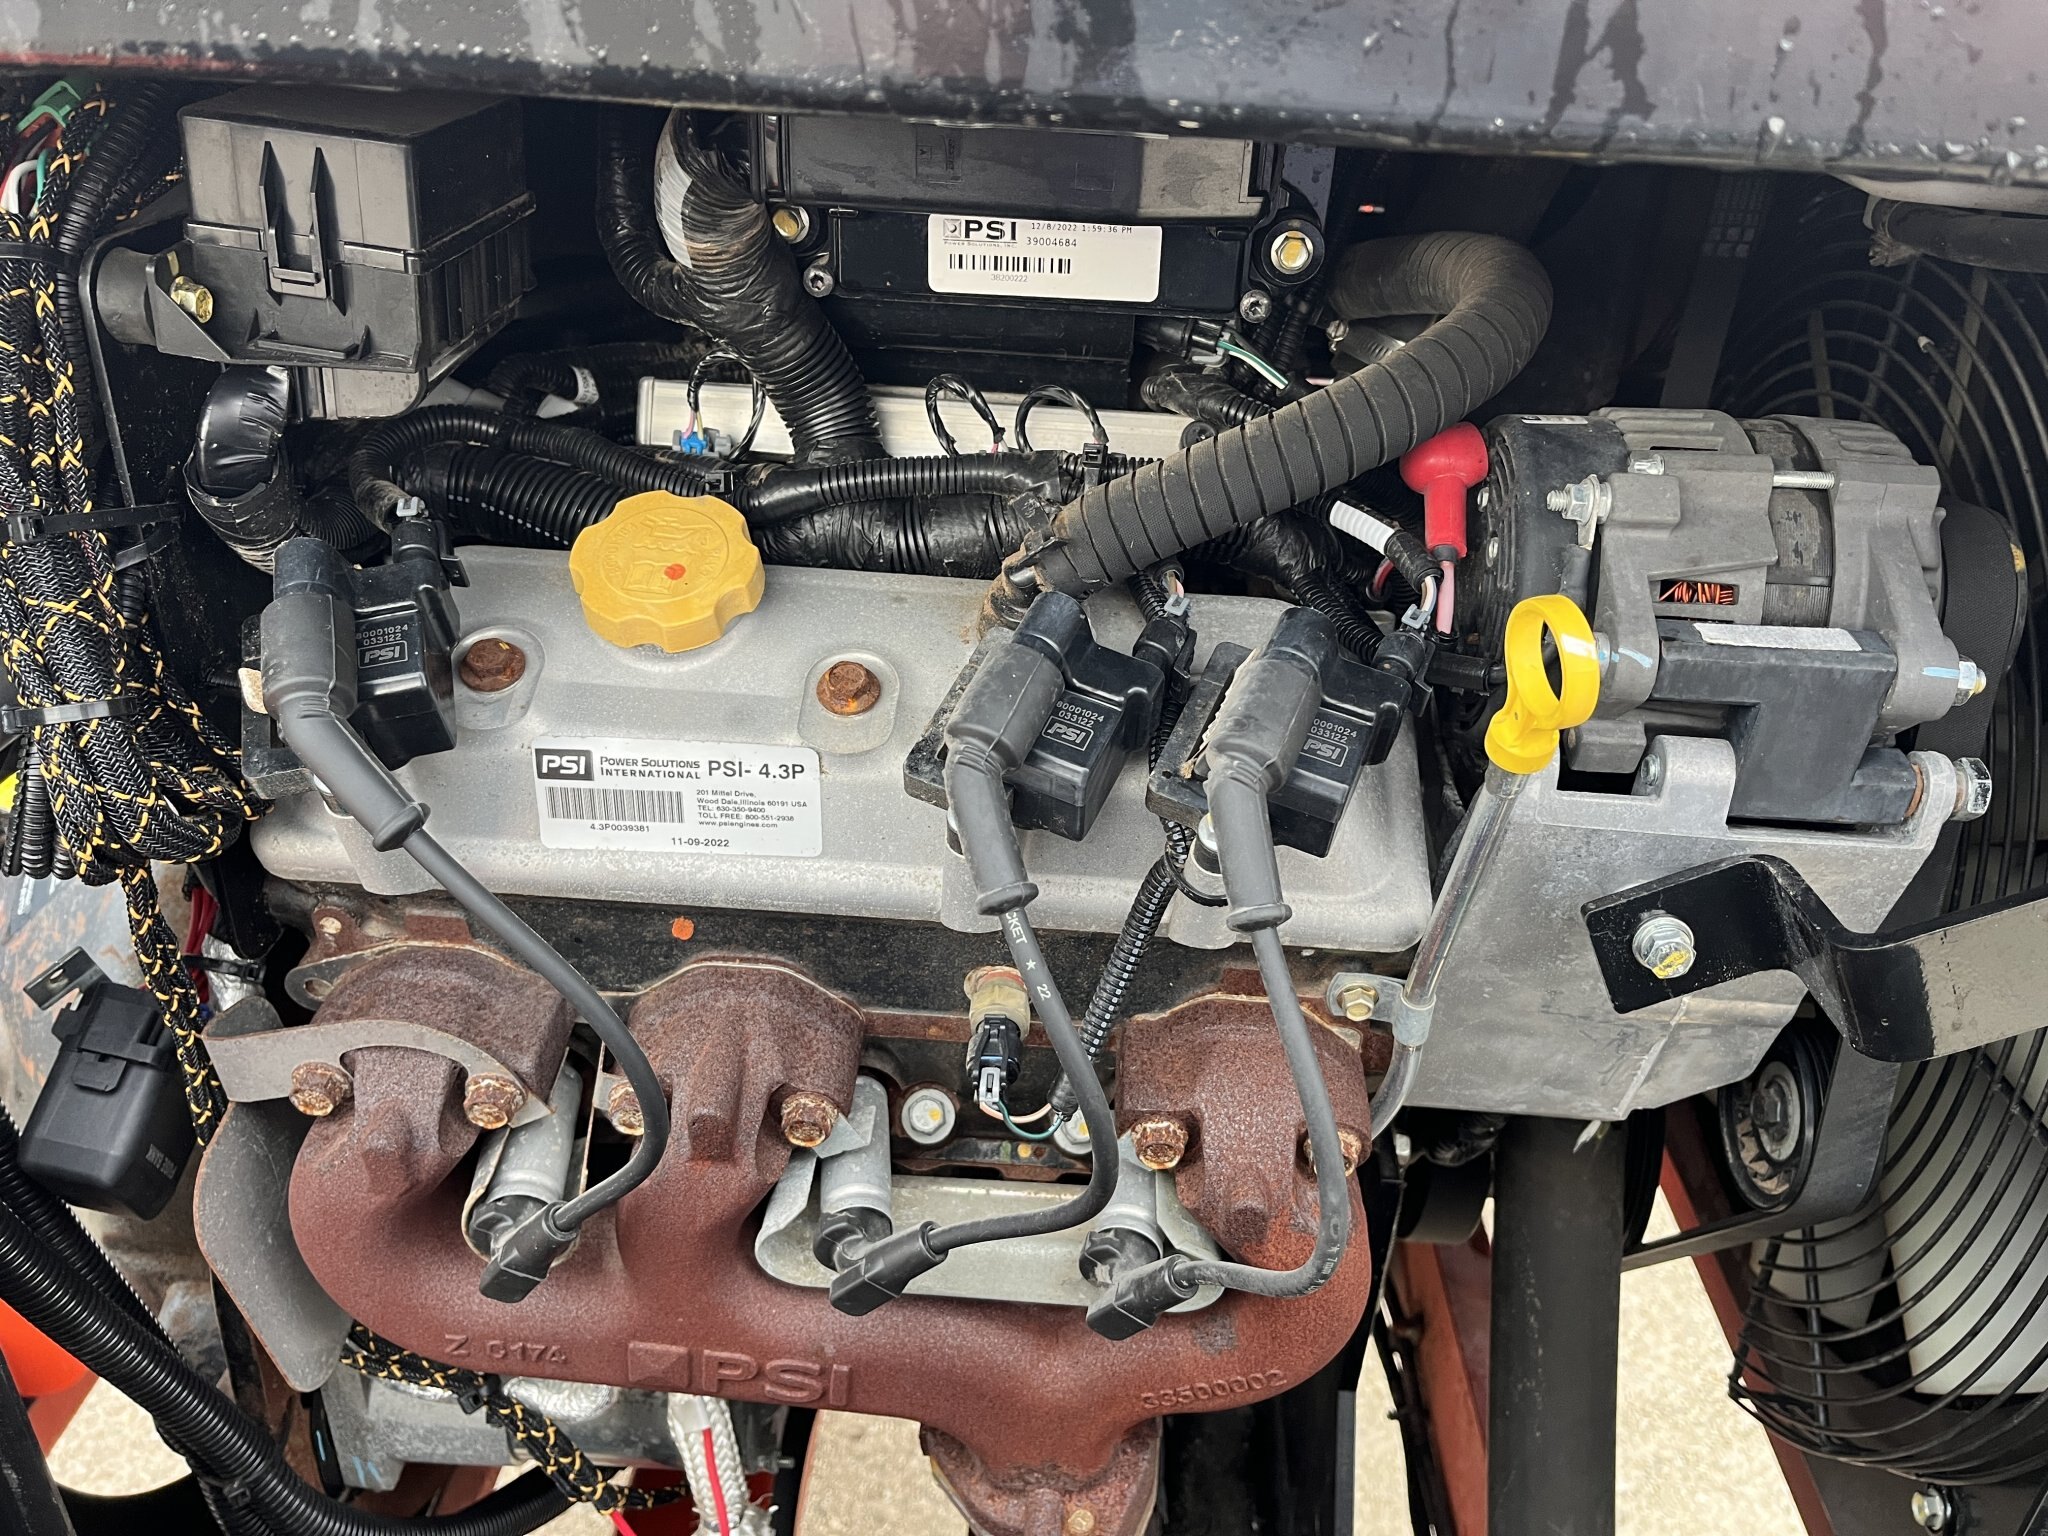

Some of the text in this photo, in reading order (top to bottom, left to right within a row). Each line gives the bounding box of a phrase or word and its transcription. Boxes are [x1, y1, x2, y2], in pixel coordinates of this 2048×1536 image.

[964, 219, 1017, 241] PSI
[1031, 222, 1077, 232] 12/8/2022
[1082, 225, 1118, 234] 1:59:36
[1026, 236, 1077, 247] 39004684
[990, 274, 1028, 283] 38200222
[363, 633, 402, 646] 033122
[363, 645, 401, 664] PSI
[1056, 700, 1104, 722] 80001024
[1058, 710, 1094, 728] 033122
[1046, 722, 1087, 744] PSI
[1310, 726, 1348, 744] 033122
[1313, 718, 1357, 738] 0001024
[1303, 738, 1342, 760] PSI
[541, 754, 587, 775] PSI
[600, 756, 701, 769] POWER SOLUTIONS
[708, 760, 805, 780] PSI- 4.3P
[600, 767, 701, 780] INTERNATIONAL
[696, 789, 709, 797] 201
[734, 790, 757, 799] Drive,
[697, 797, 719, 806] Wood
[767, 800, 789, 808] 60191
[791, 801, 808, 809] USA
[698, 804, 766, 814] TEL: 630-350-9400
[699, 811, 795, 822] TOLL FREE: 800-551-2938
[590, 823, 650, 833] 4.3P0039381
[699, 820, 778, 829] www.psiengines.com
[671, 837, 730, 848] 11-09-2022
[1036, 983, 1052, 1001] 22
[444, 1333, 470, 1358] Z
[702, 1349, 852, 1406] PSI
[1141, 1369, 1288, 1408] 33500002
